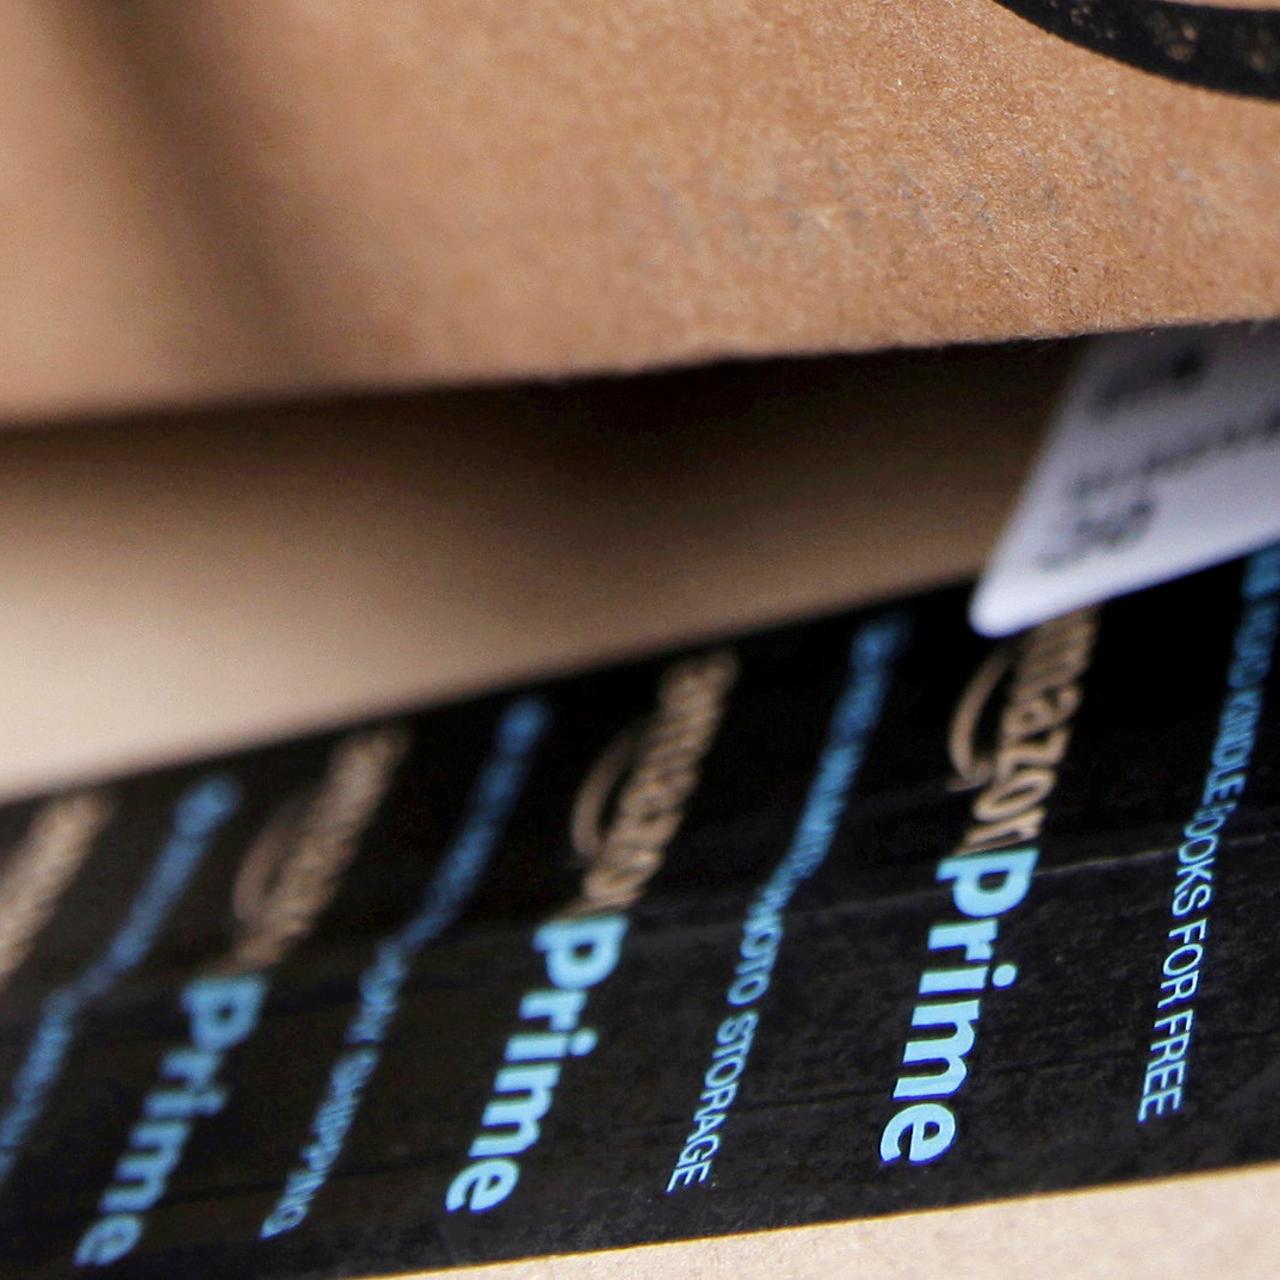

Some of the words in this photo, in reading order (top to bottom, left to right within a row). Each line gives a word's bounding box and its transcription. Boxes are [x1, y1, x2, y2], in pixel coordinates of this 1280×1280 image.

[1156, 921, 1210, 1012] FOR
[665, 1012, 760, 1196] STORAGE
[1136, 1012, 1197, 1125] FREE
